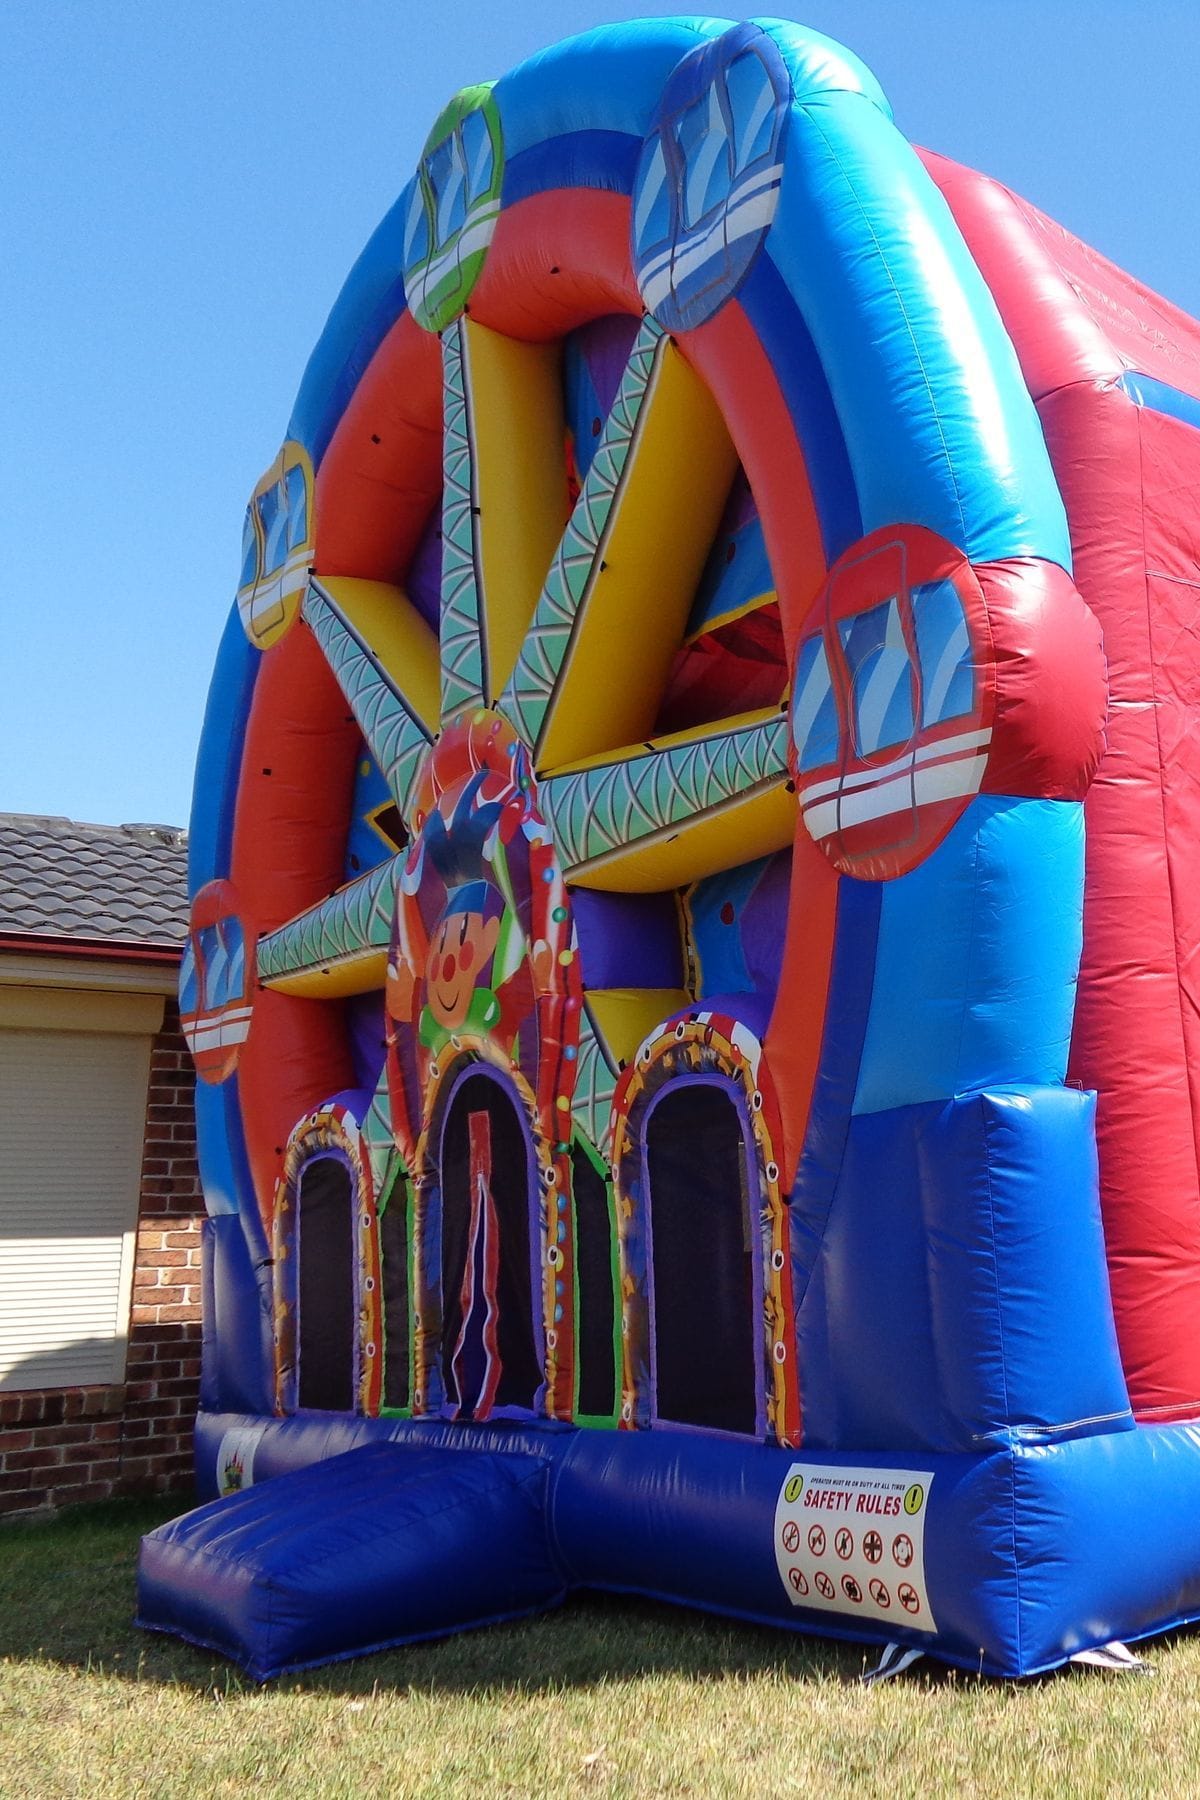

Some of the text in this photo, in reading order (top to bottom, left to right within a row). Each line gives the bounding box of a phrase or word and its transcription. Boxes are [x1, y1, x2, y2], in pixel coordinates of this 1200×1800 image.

[859, 1481, 873, 1489] DUTY
[881, 1482, 890, 1490] ALL
[804, 1489, 901, 1516] SAFETY RULES
